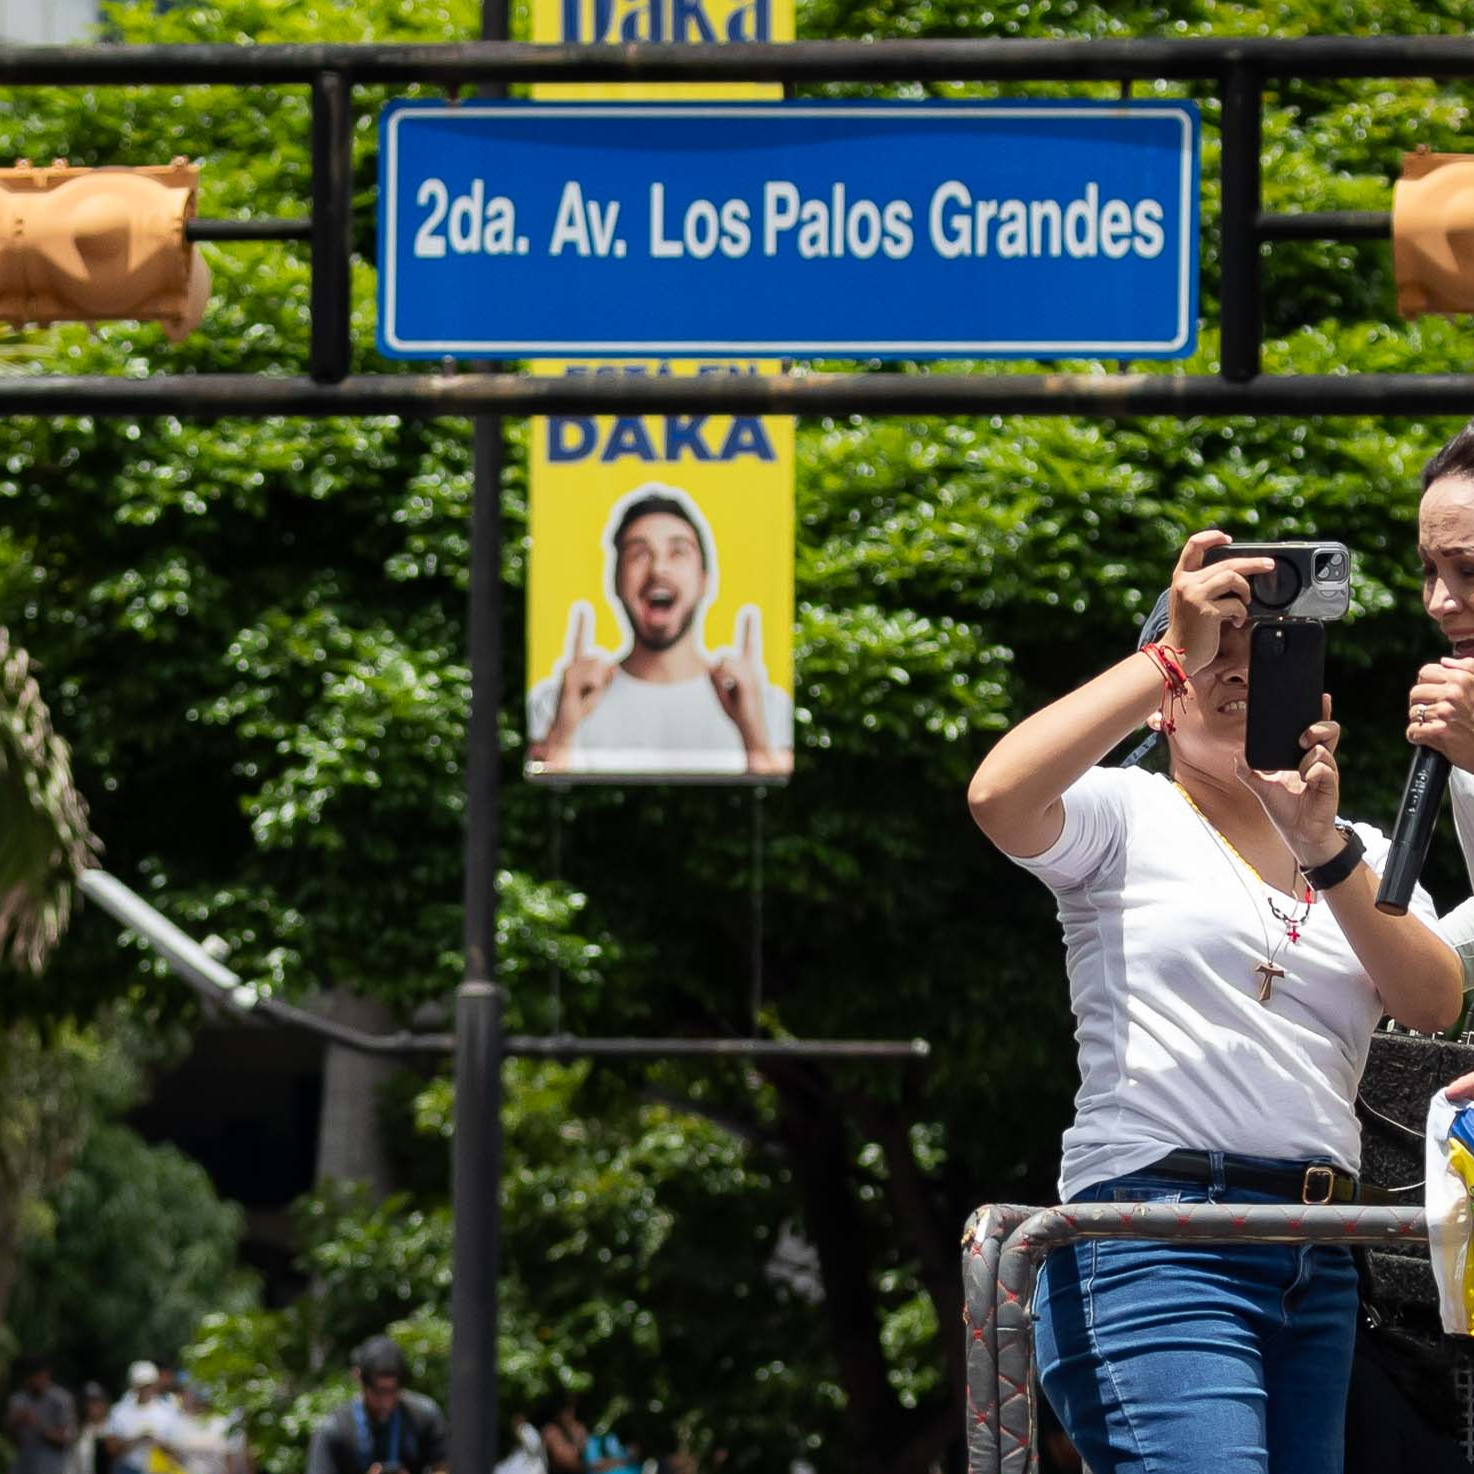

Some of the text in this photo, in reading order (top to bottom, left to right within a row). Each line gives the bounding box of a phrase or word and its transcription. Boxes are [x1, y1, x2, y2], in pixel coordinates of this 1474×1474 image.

[413, 178, 1165, 260] 2da. Av. Los Palos Grandes
[546, 414, 776, 463] DAKA
